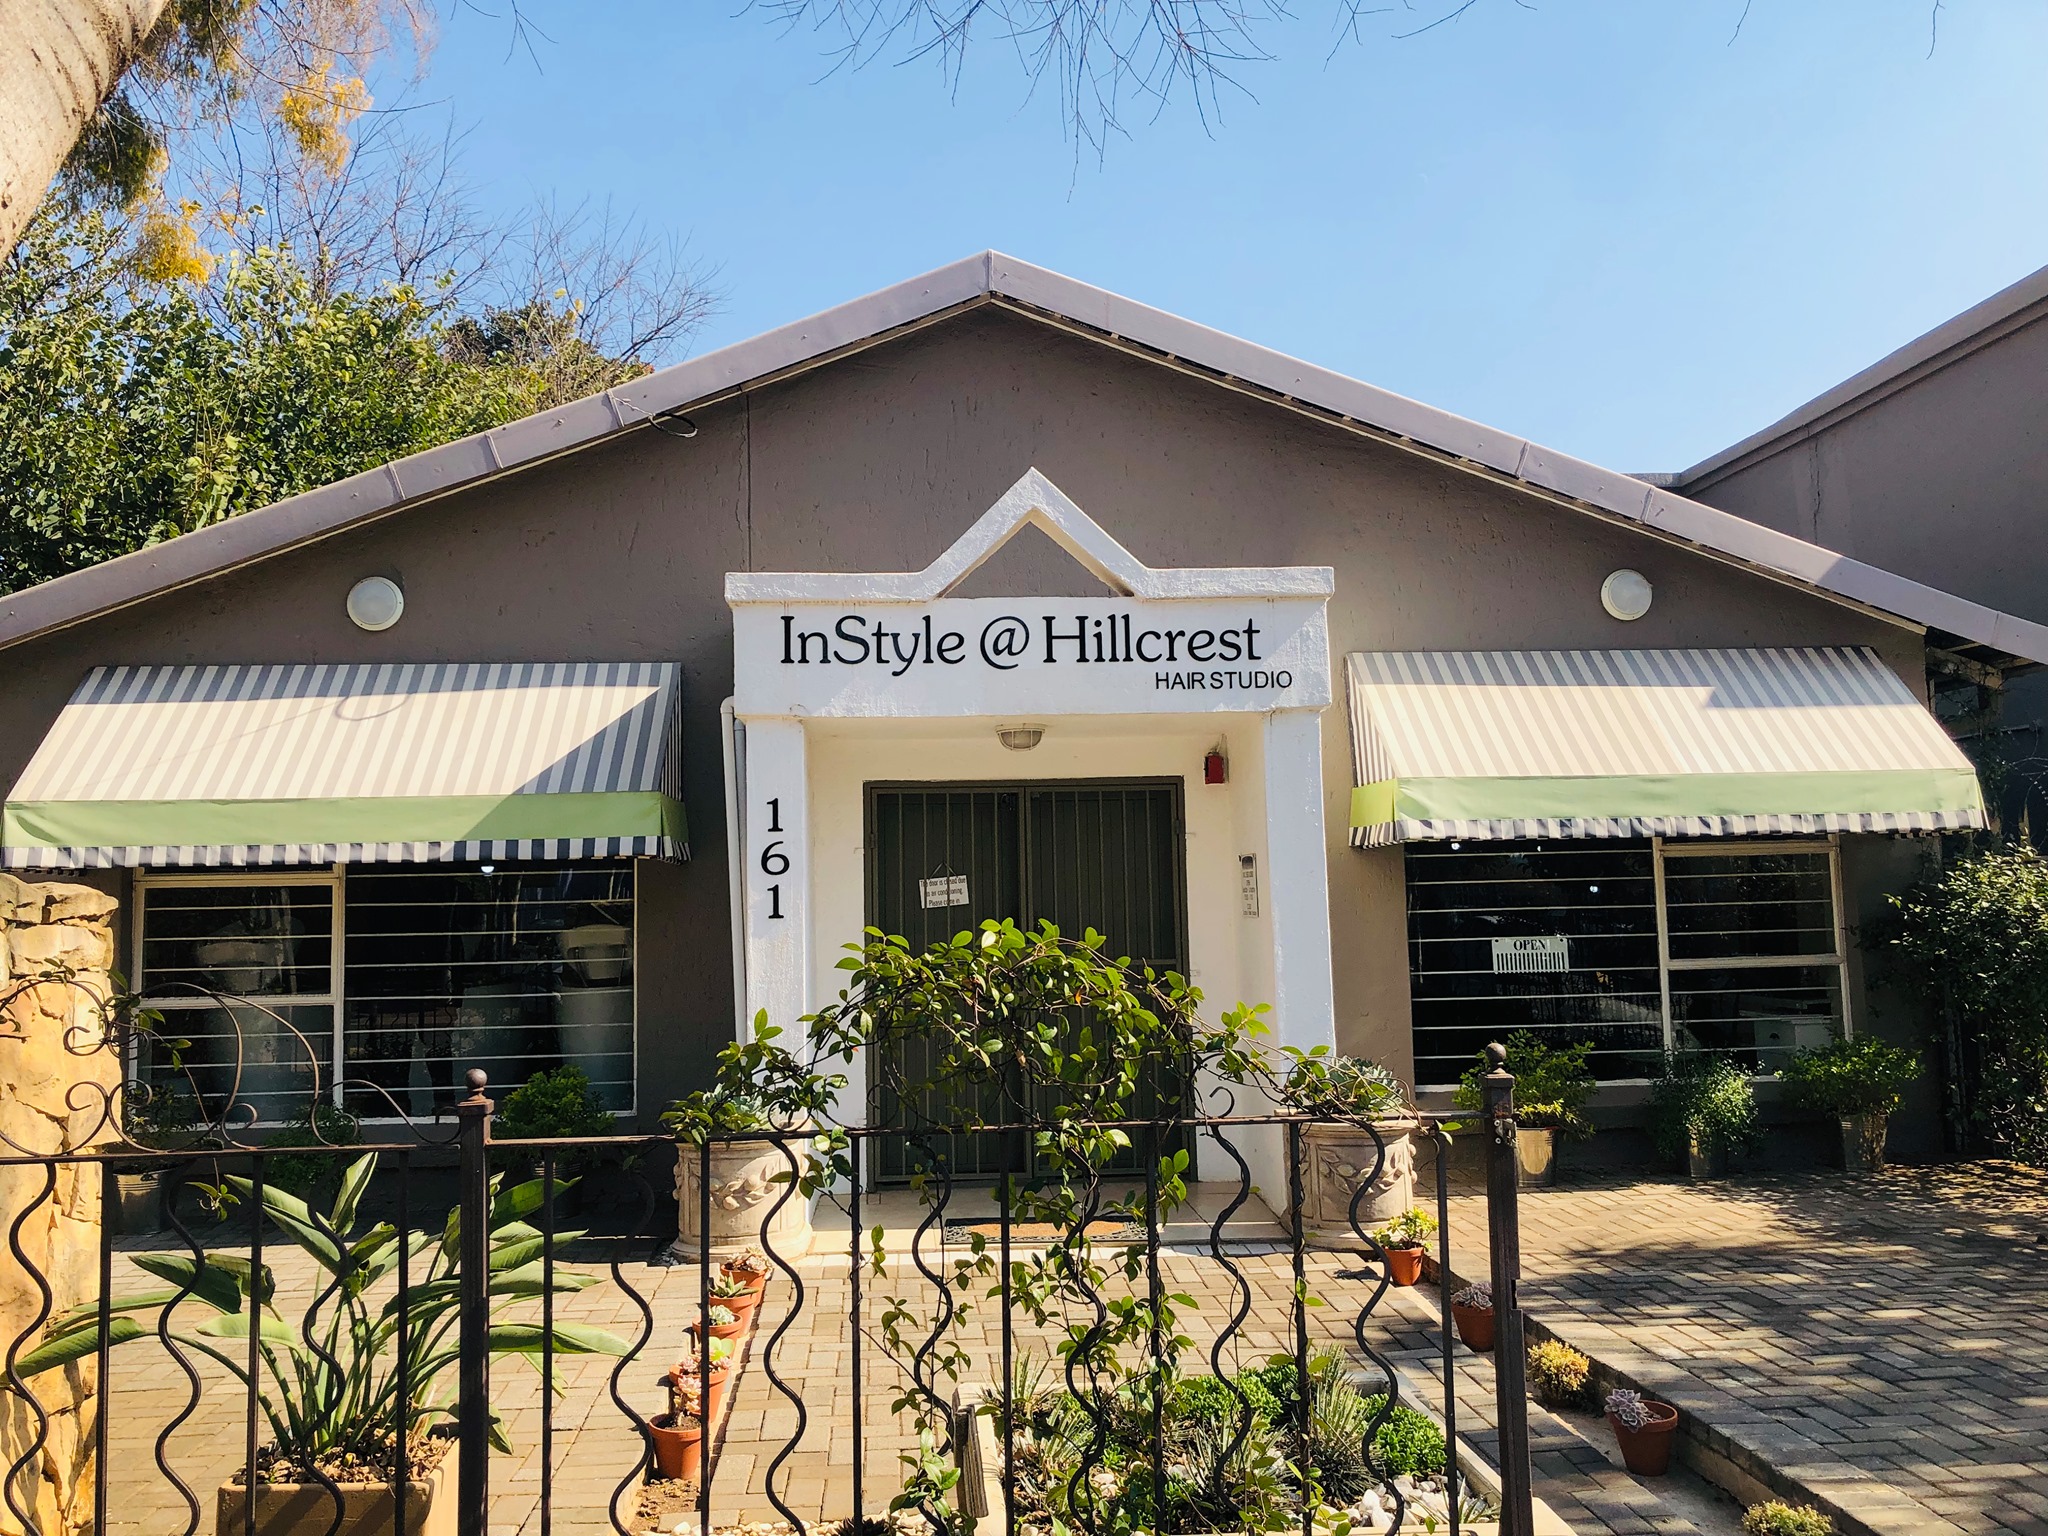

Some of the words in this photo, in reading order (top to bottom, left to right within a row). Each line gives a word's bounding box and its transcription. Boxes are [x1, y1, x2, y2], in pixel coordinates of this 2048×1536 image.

[780, 614, 965, 677] InStyle
[979, 615, 1030, 670] @
[1041, 613, 1261, 663] Hillcrest
[1155, 671, 1206, 690] HAIR
[1209, 670, 1293, 690] STUDIO
[760, 797, 790, 919] 161
[1513, 939, 1549, 951] OPEN
